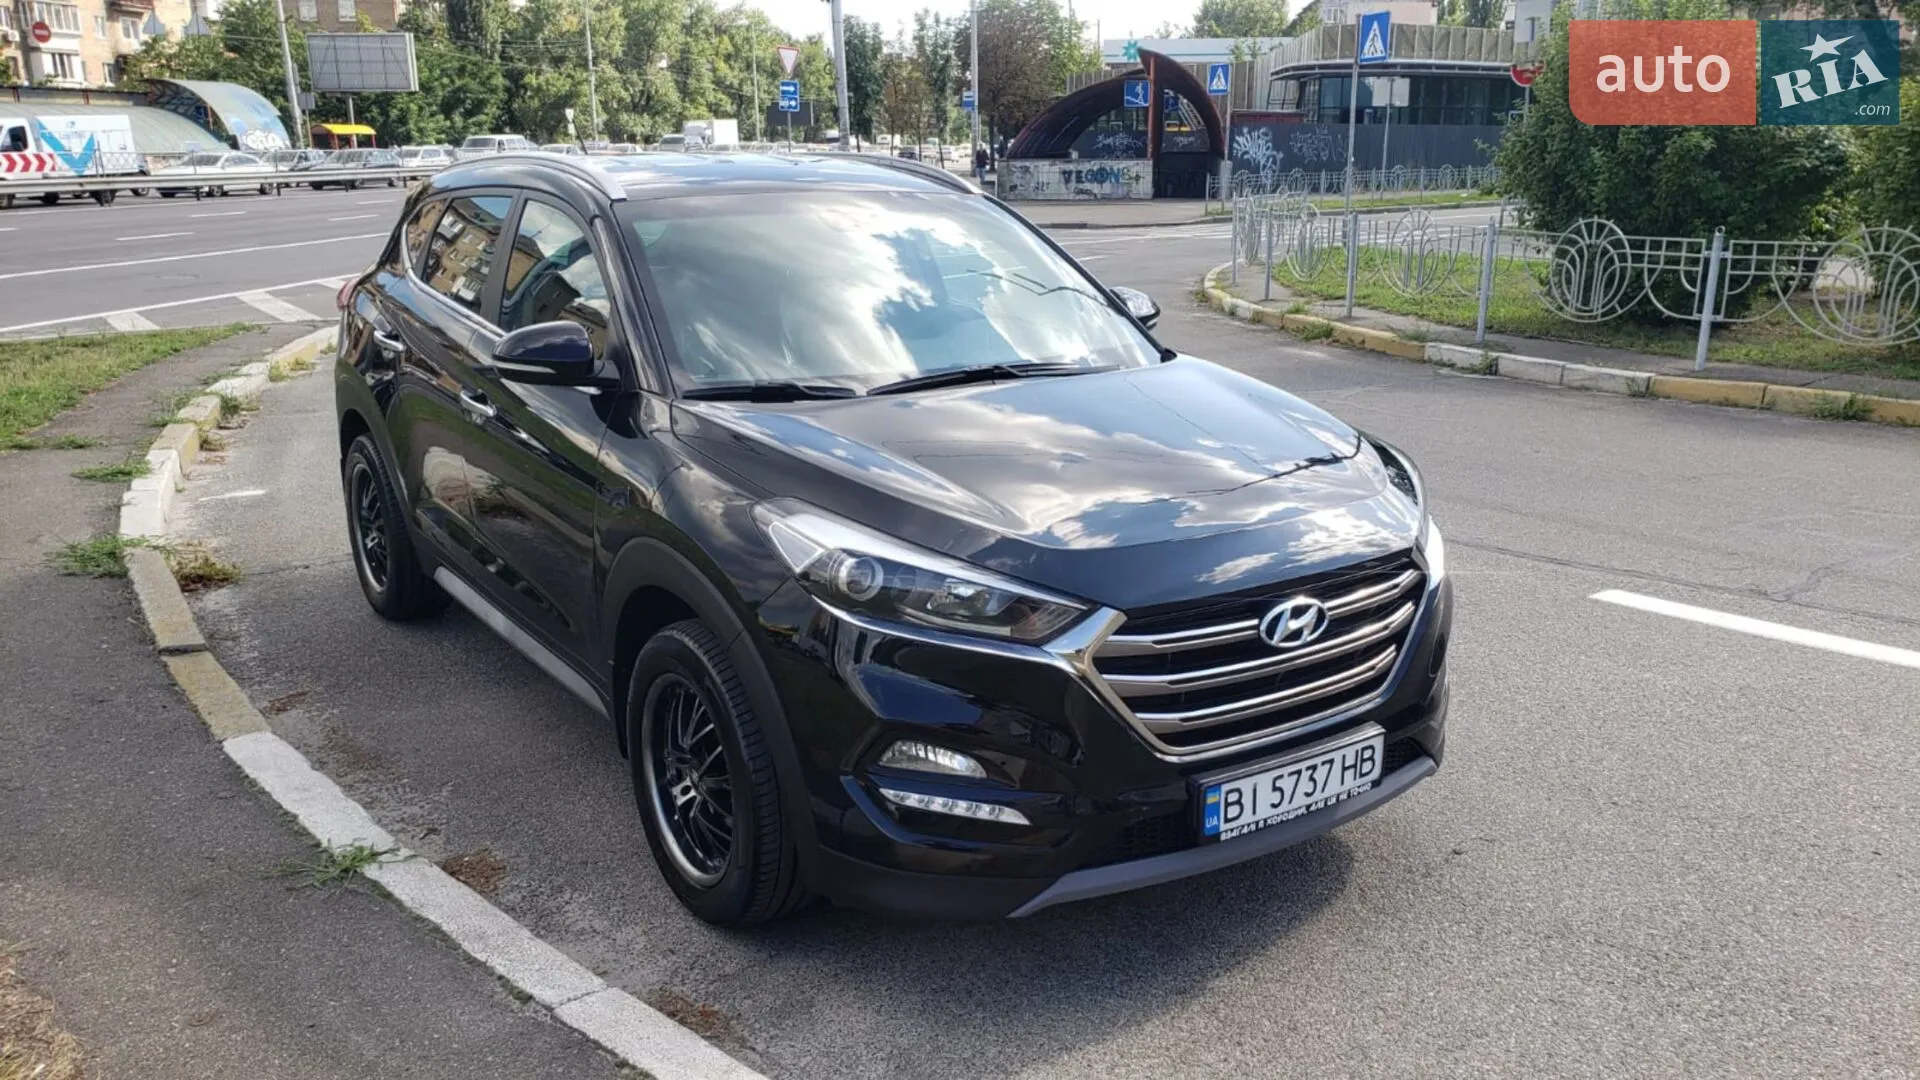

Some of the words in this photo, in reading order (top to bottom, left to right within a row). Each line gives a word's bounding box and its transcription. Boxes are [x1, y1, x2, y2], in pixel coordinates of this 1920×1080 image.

[1223, 782, 1257, 825] BI
[1270, 757, 1335, 809] 5737
[1340, 744, 1376, 786] HB
[1205, 815, 1219, 828] UA
